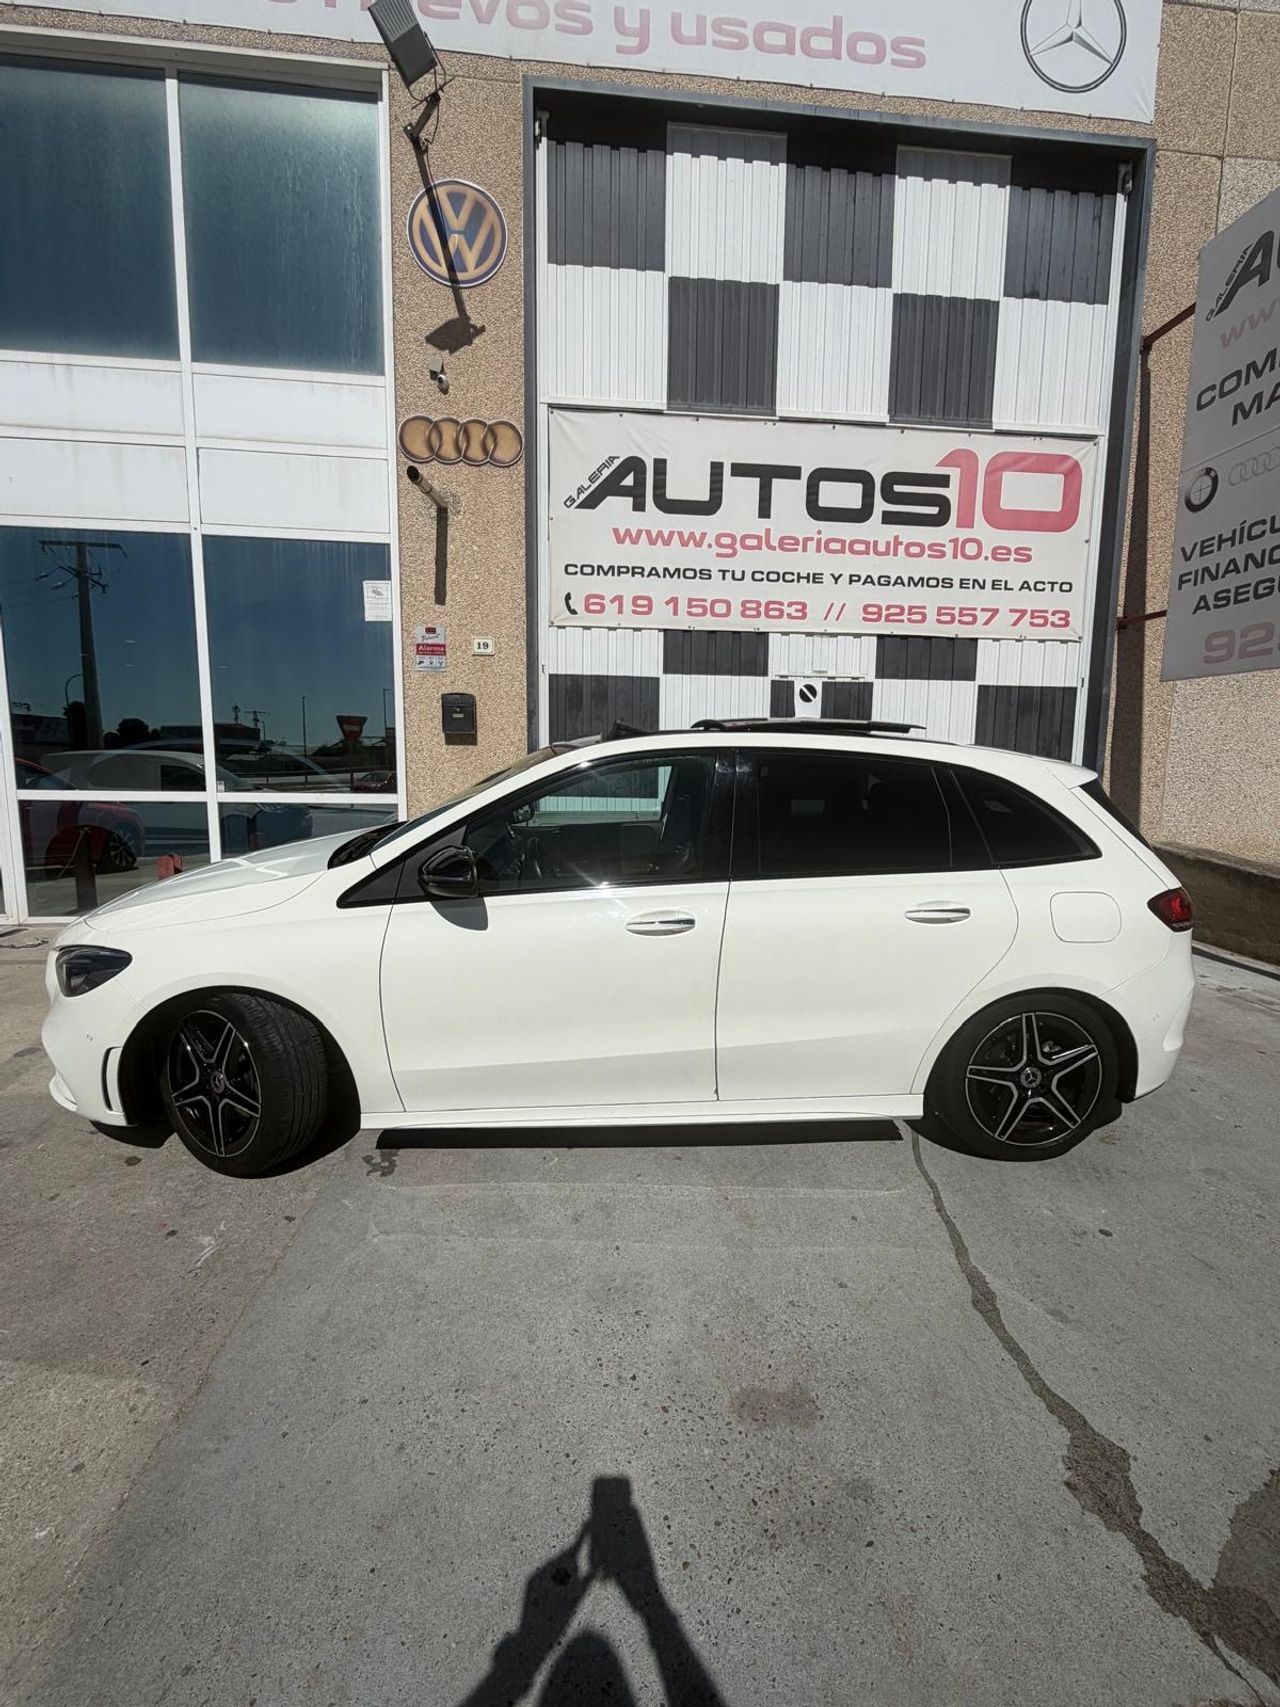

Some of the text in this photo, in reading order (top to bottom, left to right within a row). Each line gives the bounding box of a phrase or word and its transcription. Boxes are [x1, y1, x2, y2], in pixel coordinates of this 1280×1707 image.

[325, 0, 926, 69] evos y usados
[1196, 347, 1280, 412] COM
[564, 455, 620, 509] GALERIA
[612, 527, 1033, 564] www.galeriaautos10.es
[564, 563, 1073, 593] COMPRAMOS TU COCHE Y PAGAMOS EN EL ACTO
[1192, 574, 1280, 615] ASEG
[584, 593, 653, 616] 619
[664, 596, 732, 618] 150
[740, 599, 808, 620] 863
[862, 603, 927, 624] 925
[935, 606, 999, 626] 557
[1009, 608, 1071, 629] 753
[476, 641, 489, 650] 19
[1203, 621, 1280, 664] 92
